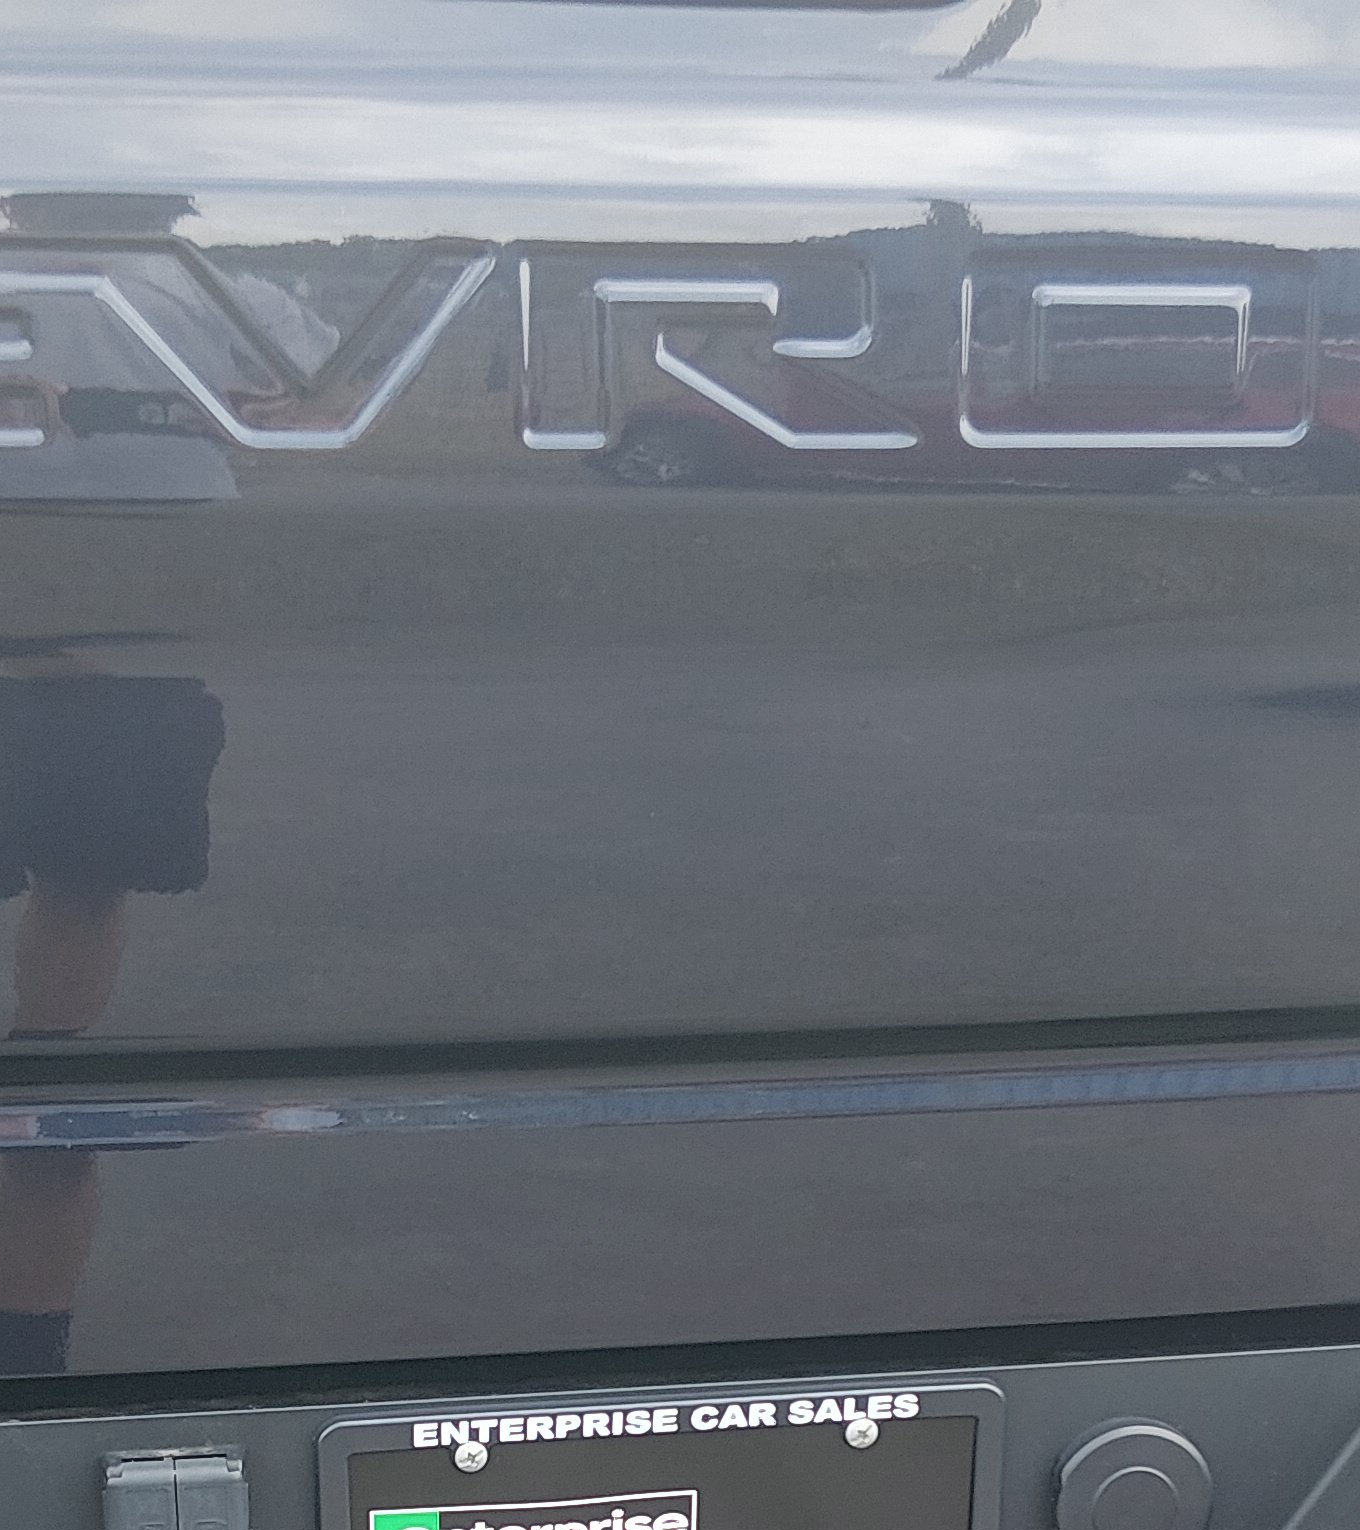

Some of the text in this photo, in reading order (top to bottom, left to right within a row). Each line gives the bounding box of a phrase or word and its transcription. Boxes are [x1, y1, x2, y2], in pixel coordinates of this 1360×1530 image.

[412, 1393, 920, 1448] ENTERPRISE CAR SALES
